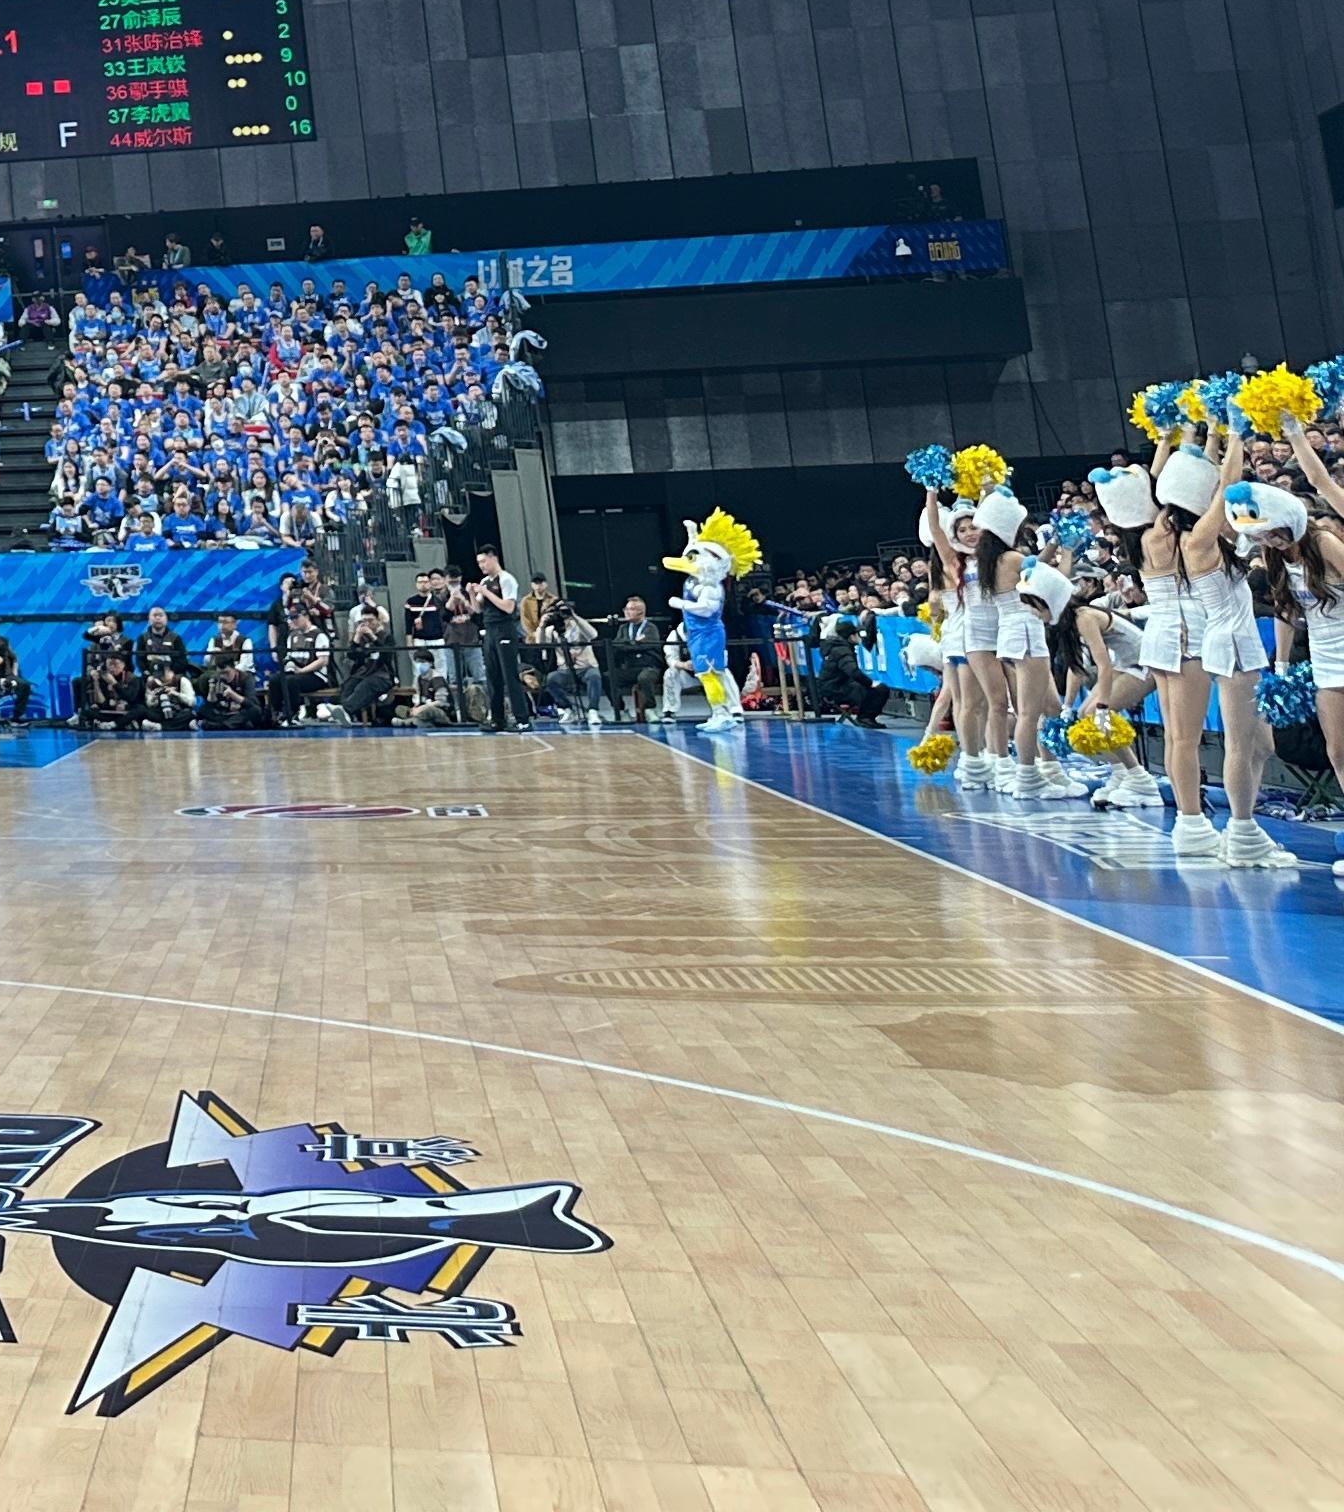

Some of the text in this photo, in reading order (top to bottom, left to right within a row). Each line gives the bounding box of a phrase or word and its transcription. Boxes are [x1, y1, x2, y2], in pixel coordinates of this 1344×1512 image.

[275, 0, 287, 14] 3
[278, 23, 290, 39] 2
[280, 47, 293, 63] 9
[284, 70, 307, 87] 10
[285, 95, 297, 111] 0
[58, 121, 78, 147] F
[289, 119, 312, 135] 16
[90, 564, 141, 579] DUCKS
